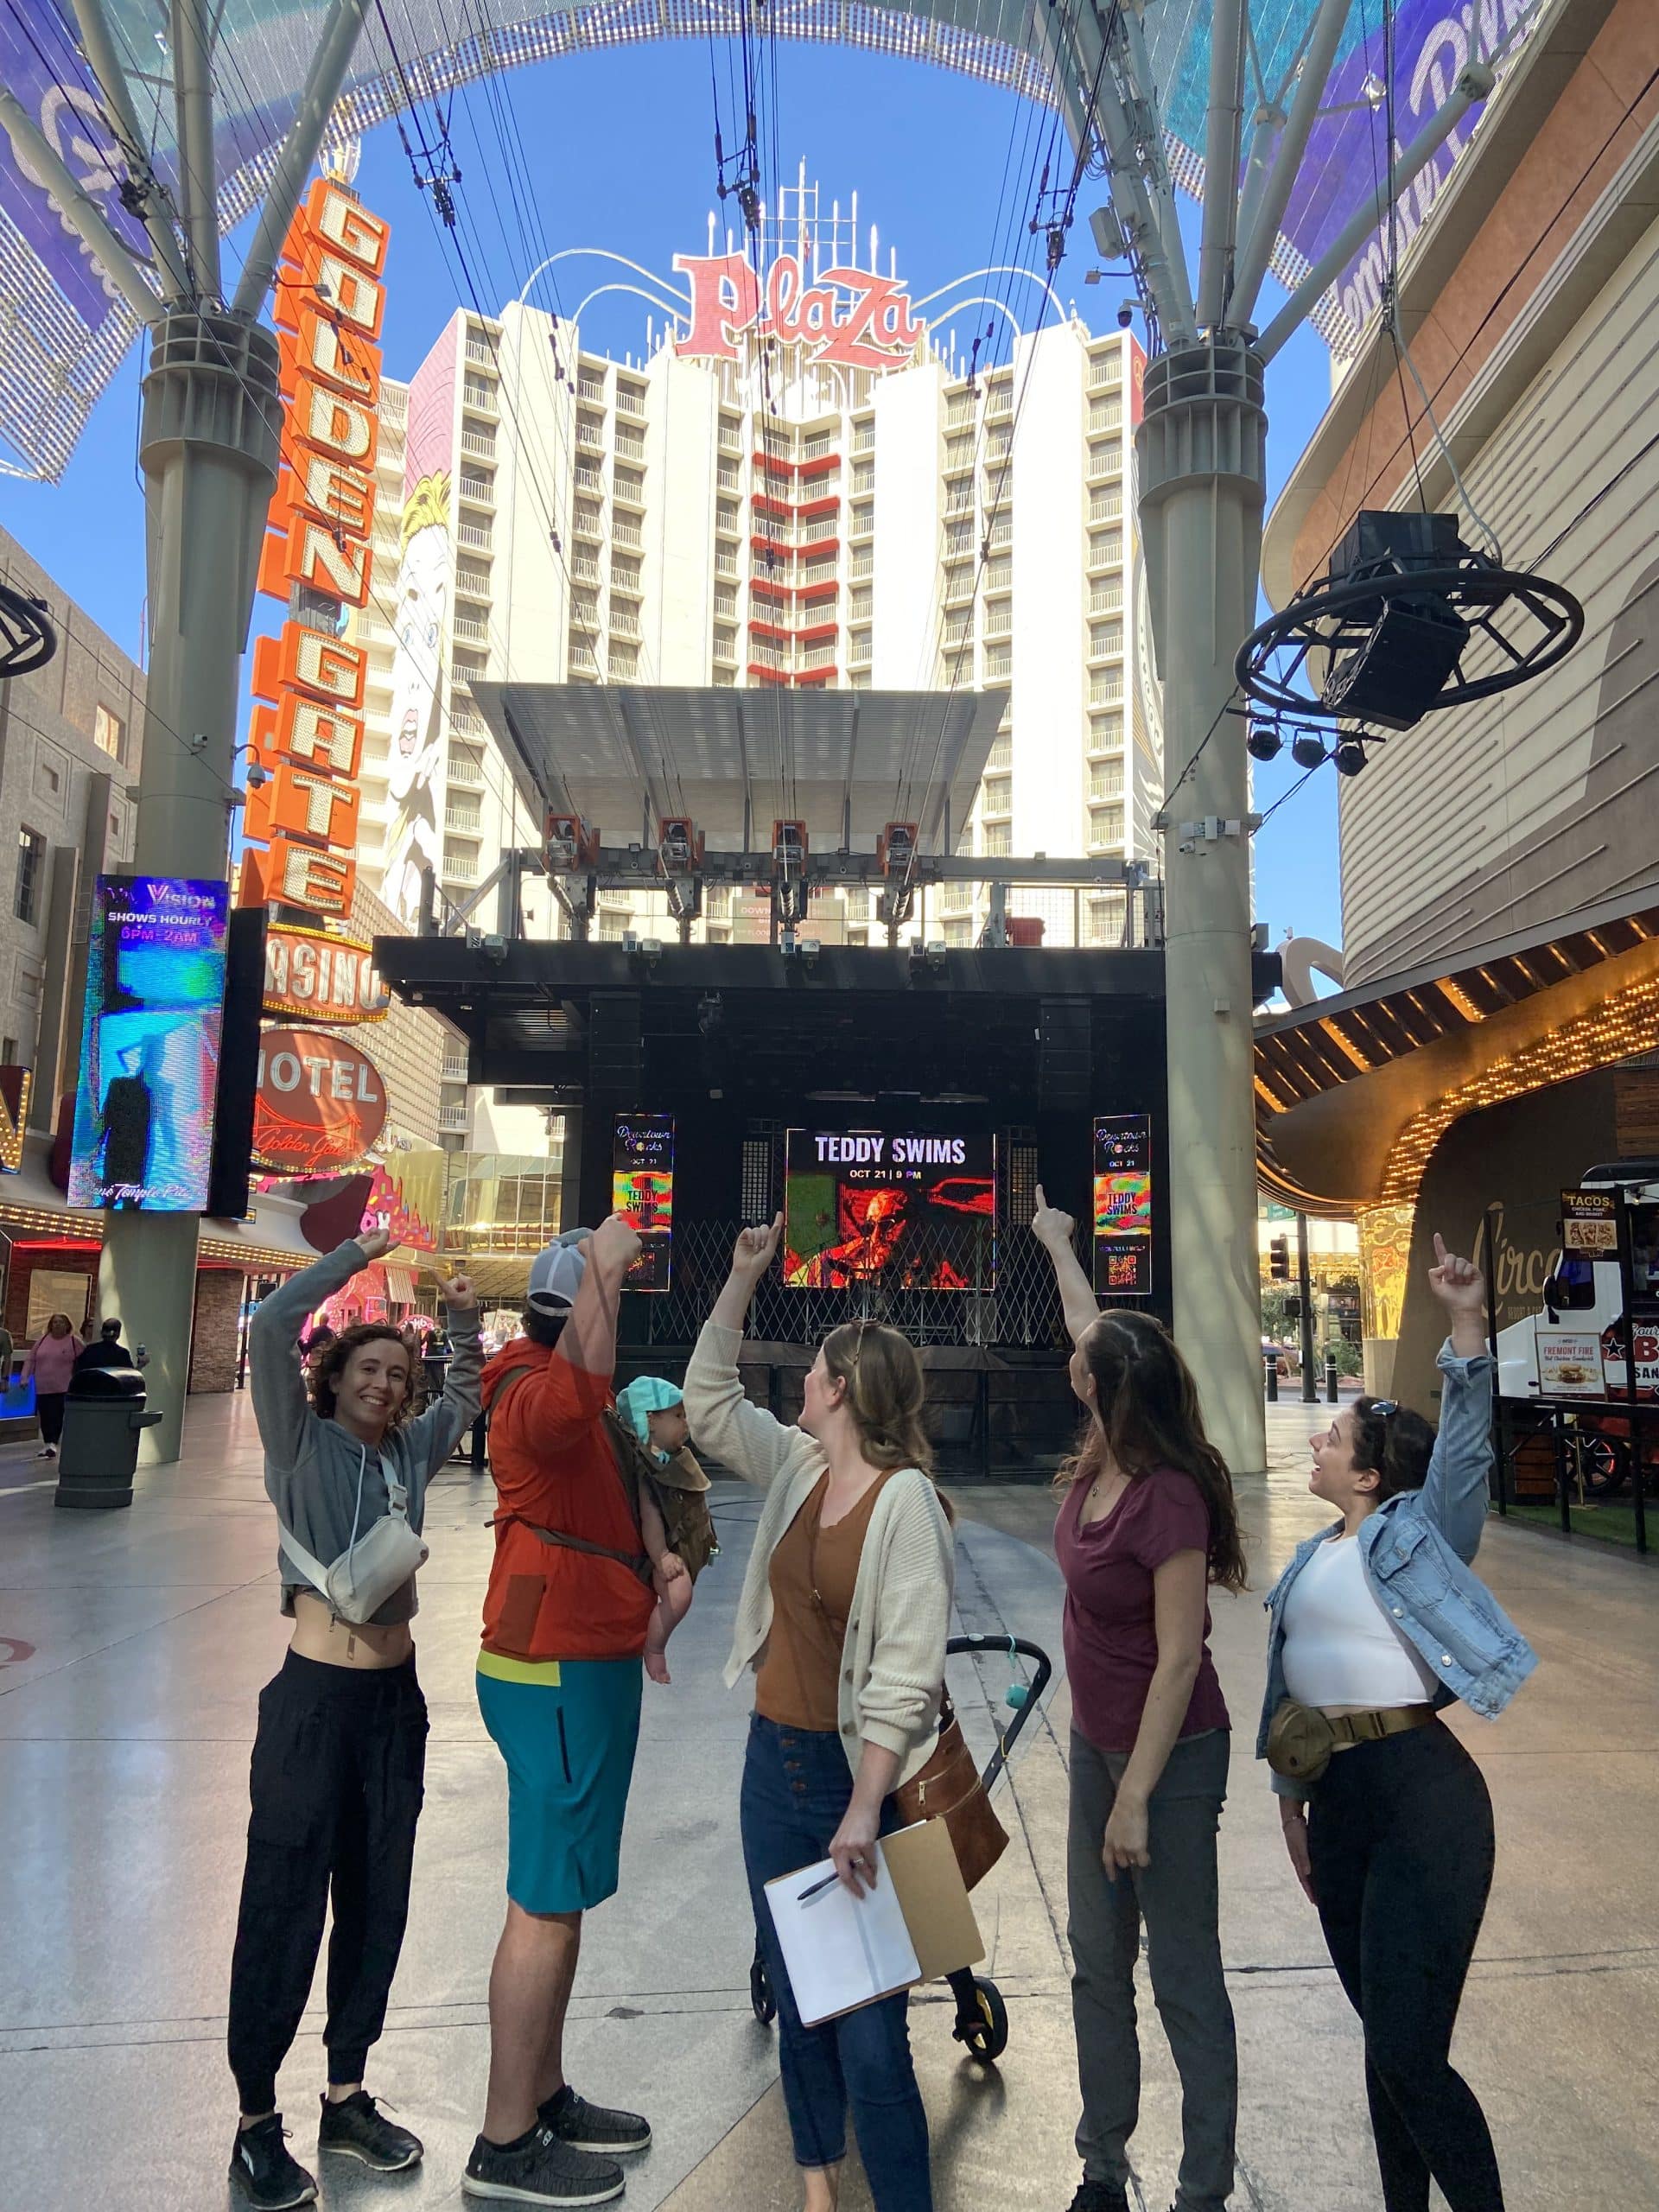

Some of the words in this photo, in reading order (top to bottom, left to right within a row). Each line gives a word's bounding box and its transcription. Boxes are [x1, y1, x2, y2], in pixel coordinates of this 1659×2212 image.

[672, 251, 926, 370] Plaza
[296, 188, 384, 600] GOLDEN
[283, 631, 360, 912] GATE
[108, 912, 156, 924] SHOWS
[160, 915, 213, 926] HOURLY
[264, 938, 381, 1010] ASINO
[255, 1127, 311, 1154] Golden
[815, 1136, 885, 1162] TEDDY
[892, 1138, 966, 1164] SWIMS
[849, 1169, 871, 1179] OCT
[874, 1169, 886, 1179] 21
[895, 1170, 903, 1179] 9
[906, 1171, 922, 1179] PM
[627, 1190, 658, 1201] TEDDY
[1107, 1192, 1137, 1205] TEDDY
[1568, 1196, 1611, 1206] TACOS
[1107, 1205, 1138, 1215] SWIMS
[1543, 1346, 1577, 1356] FREMONT
[1578, 1346, 1594, 1356] FIRE
